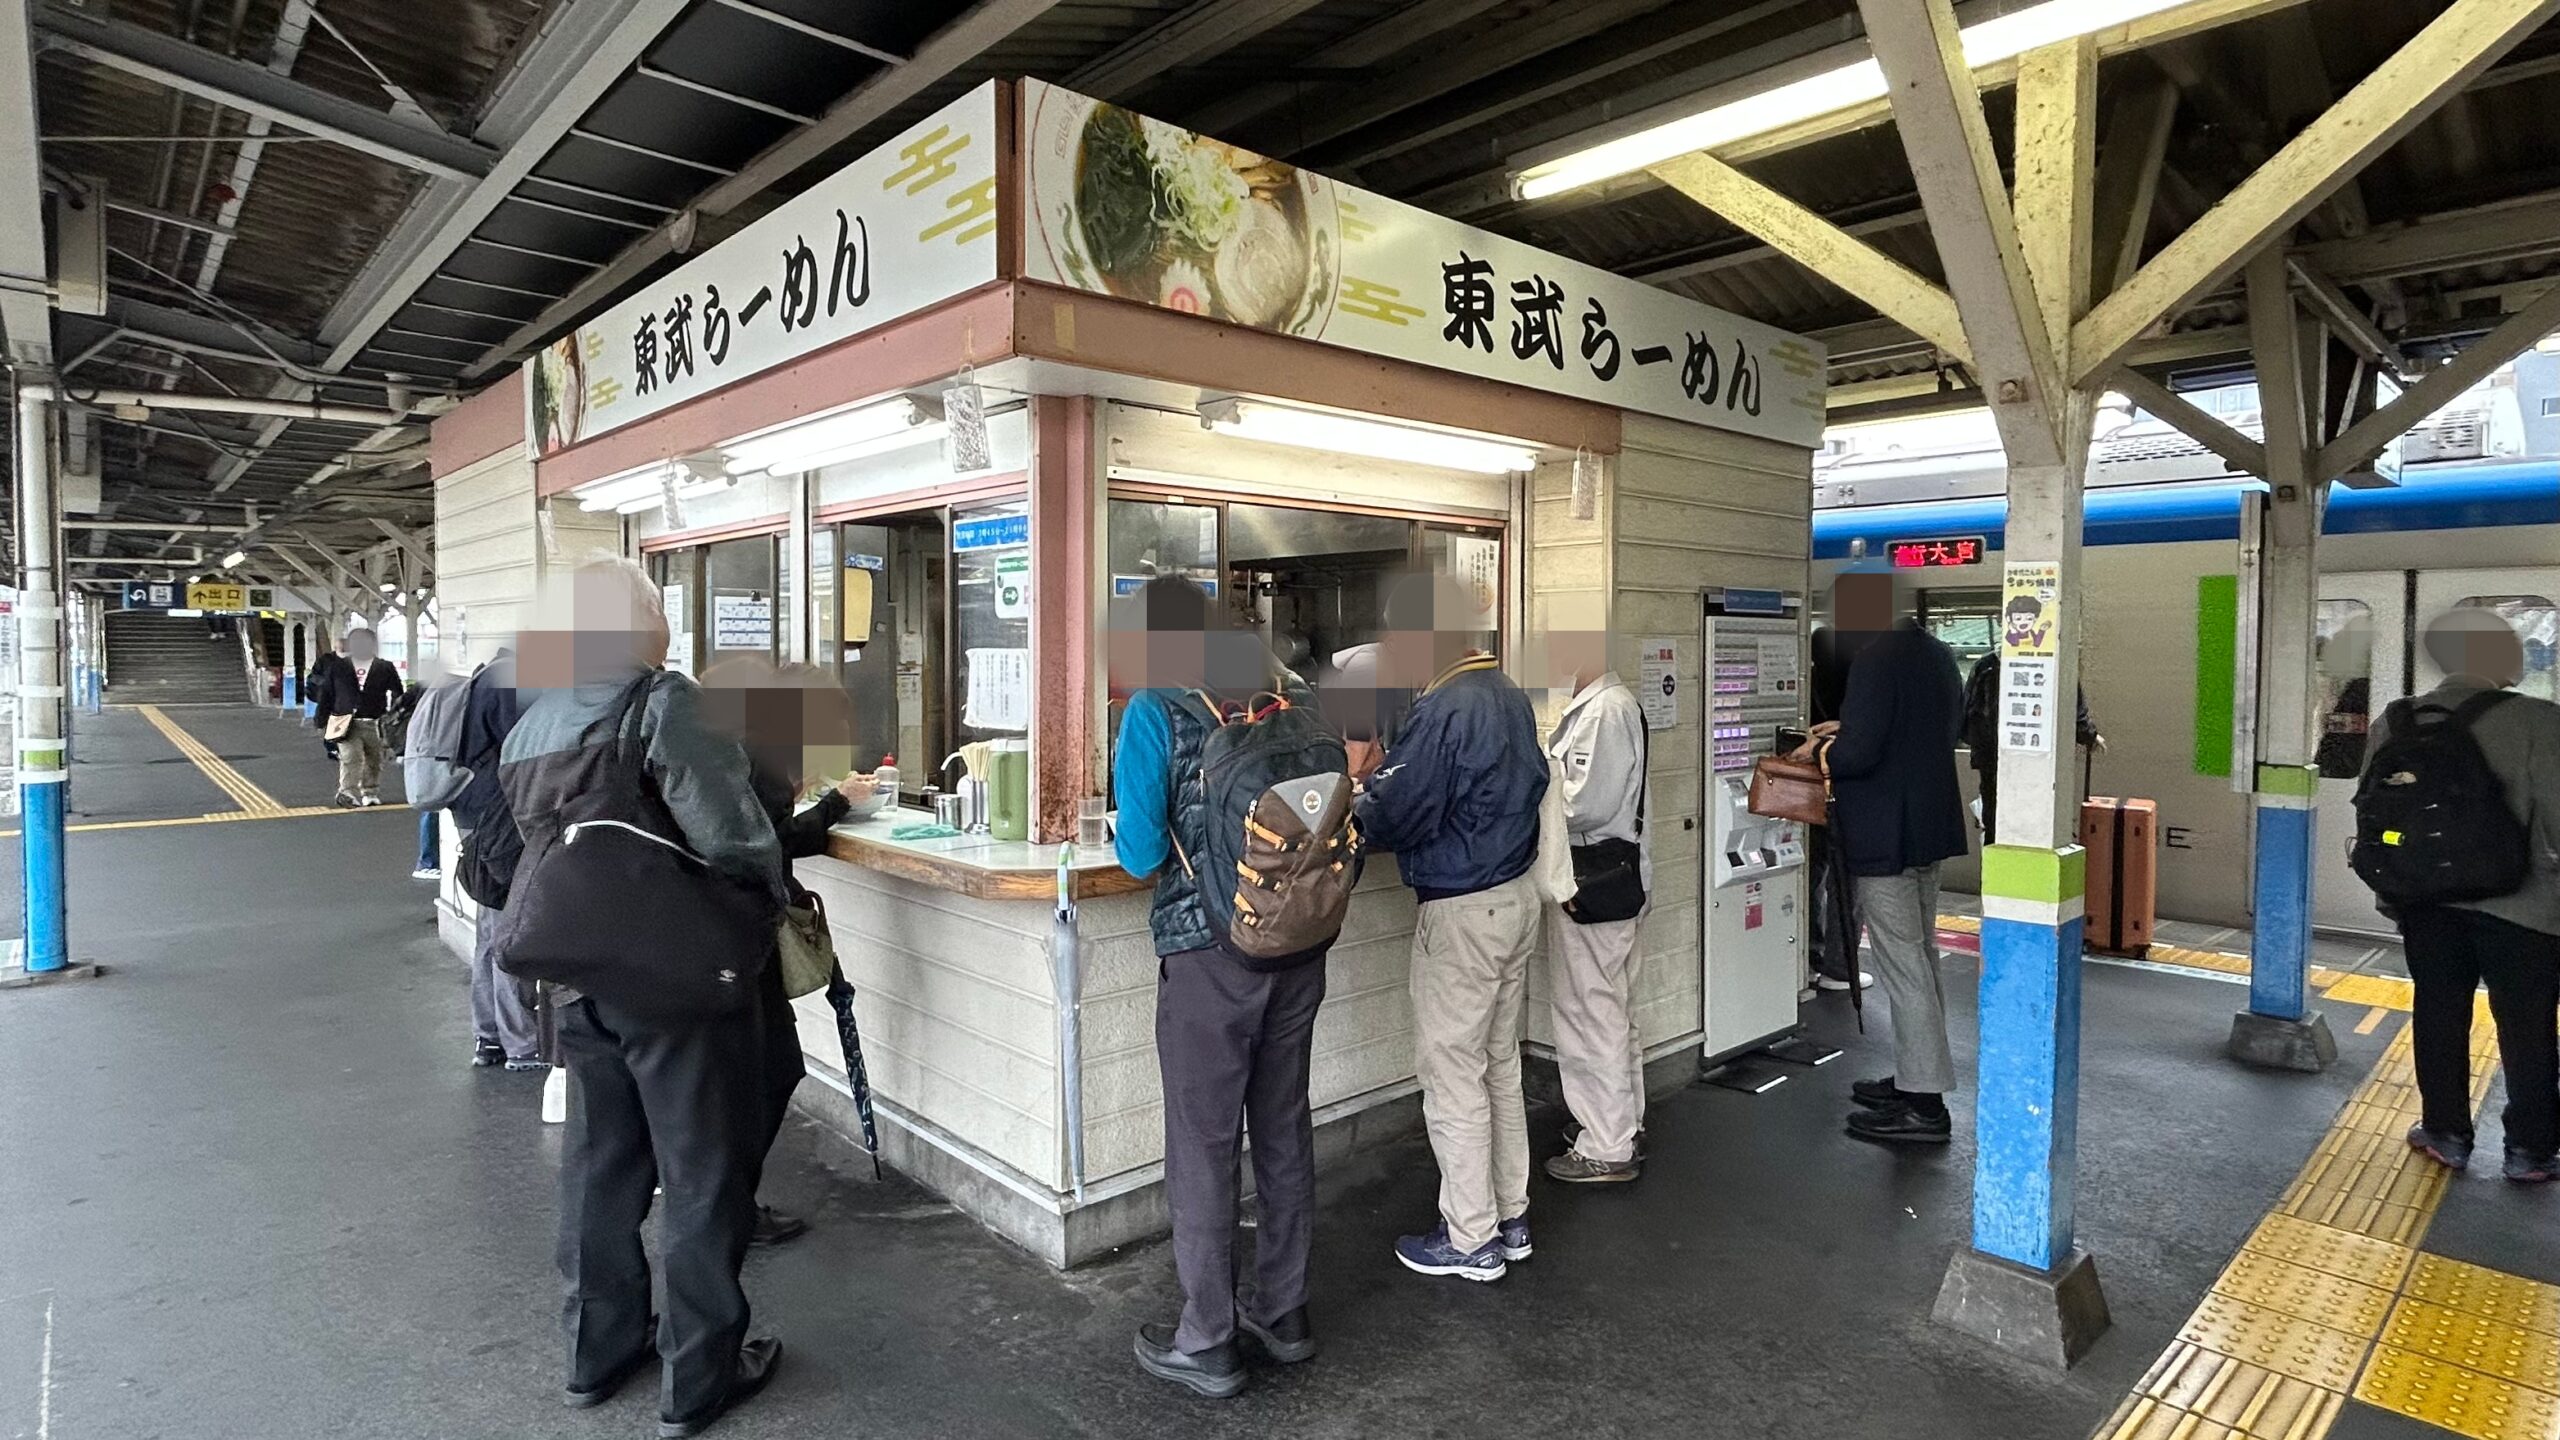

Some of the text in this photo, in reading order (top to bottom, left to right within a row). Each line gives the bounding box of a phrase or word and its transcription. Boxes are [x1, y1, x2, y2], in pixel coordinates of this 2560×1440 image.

[633, 208, 870, 397] 東武らーめん
[1441, 250, 1762, 417] 東武らーめん
[209, 589, 240, 599] 出口
[1928, 541, 1975, 561] 大宮
